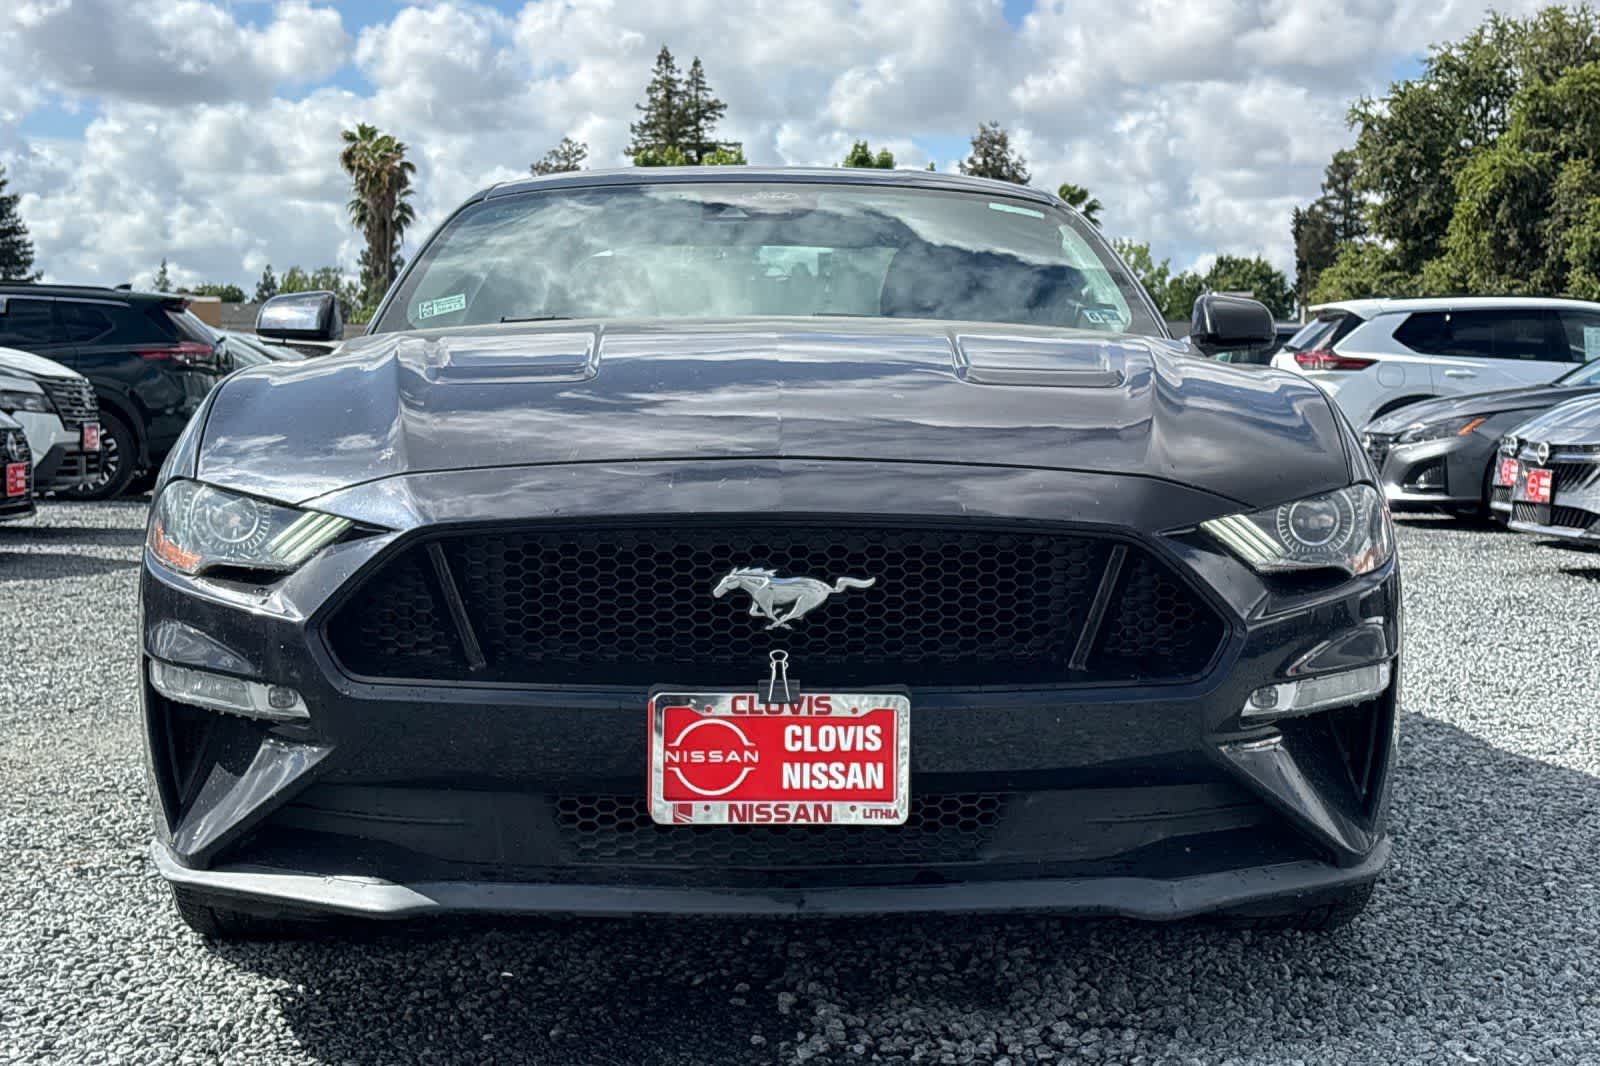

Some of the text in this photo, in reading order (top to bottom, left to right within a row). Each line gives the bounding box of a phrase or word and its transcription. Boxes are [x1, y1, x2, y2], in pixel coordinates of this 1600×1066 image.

[784, 725, 882, 752] CLOVIS
[664, 750, 759, 763] NISSAN
[782, 762, 884, 790] NISSAN
[727, 803, 832, 823] NISSAN
[863, 808, 900, 820] LITHIA
